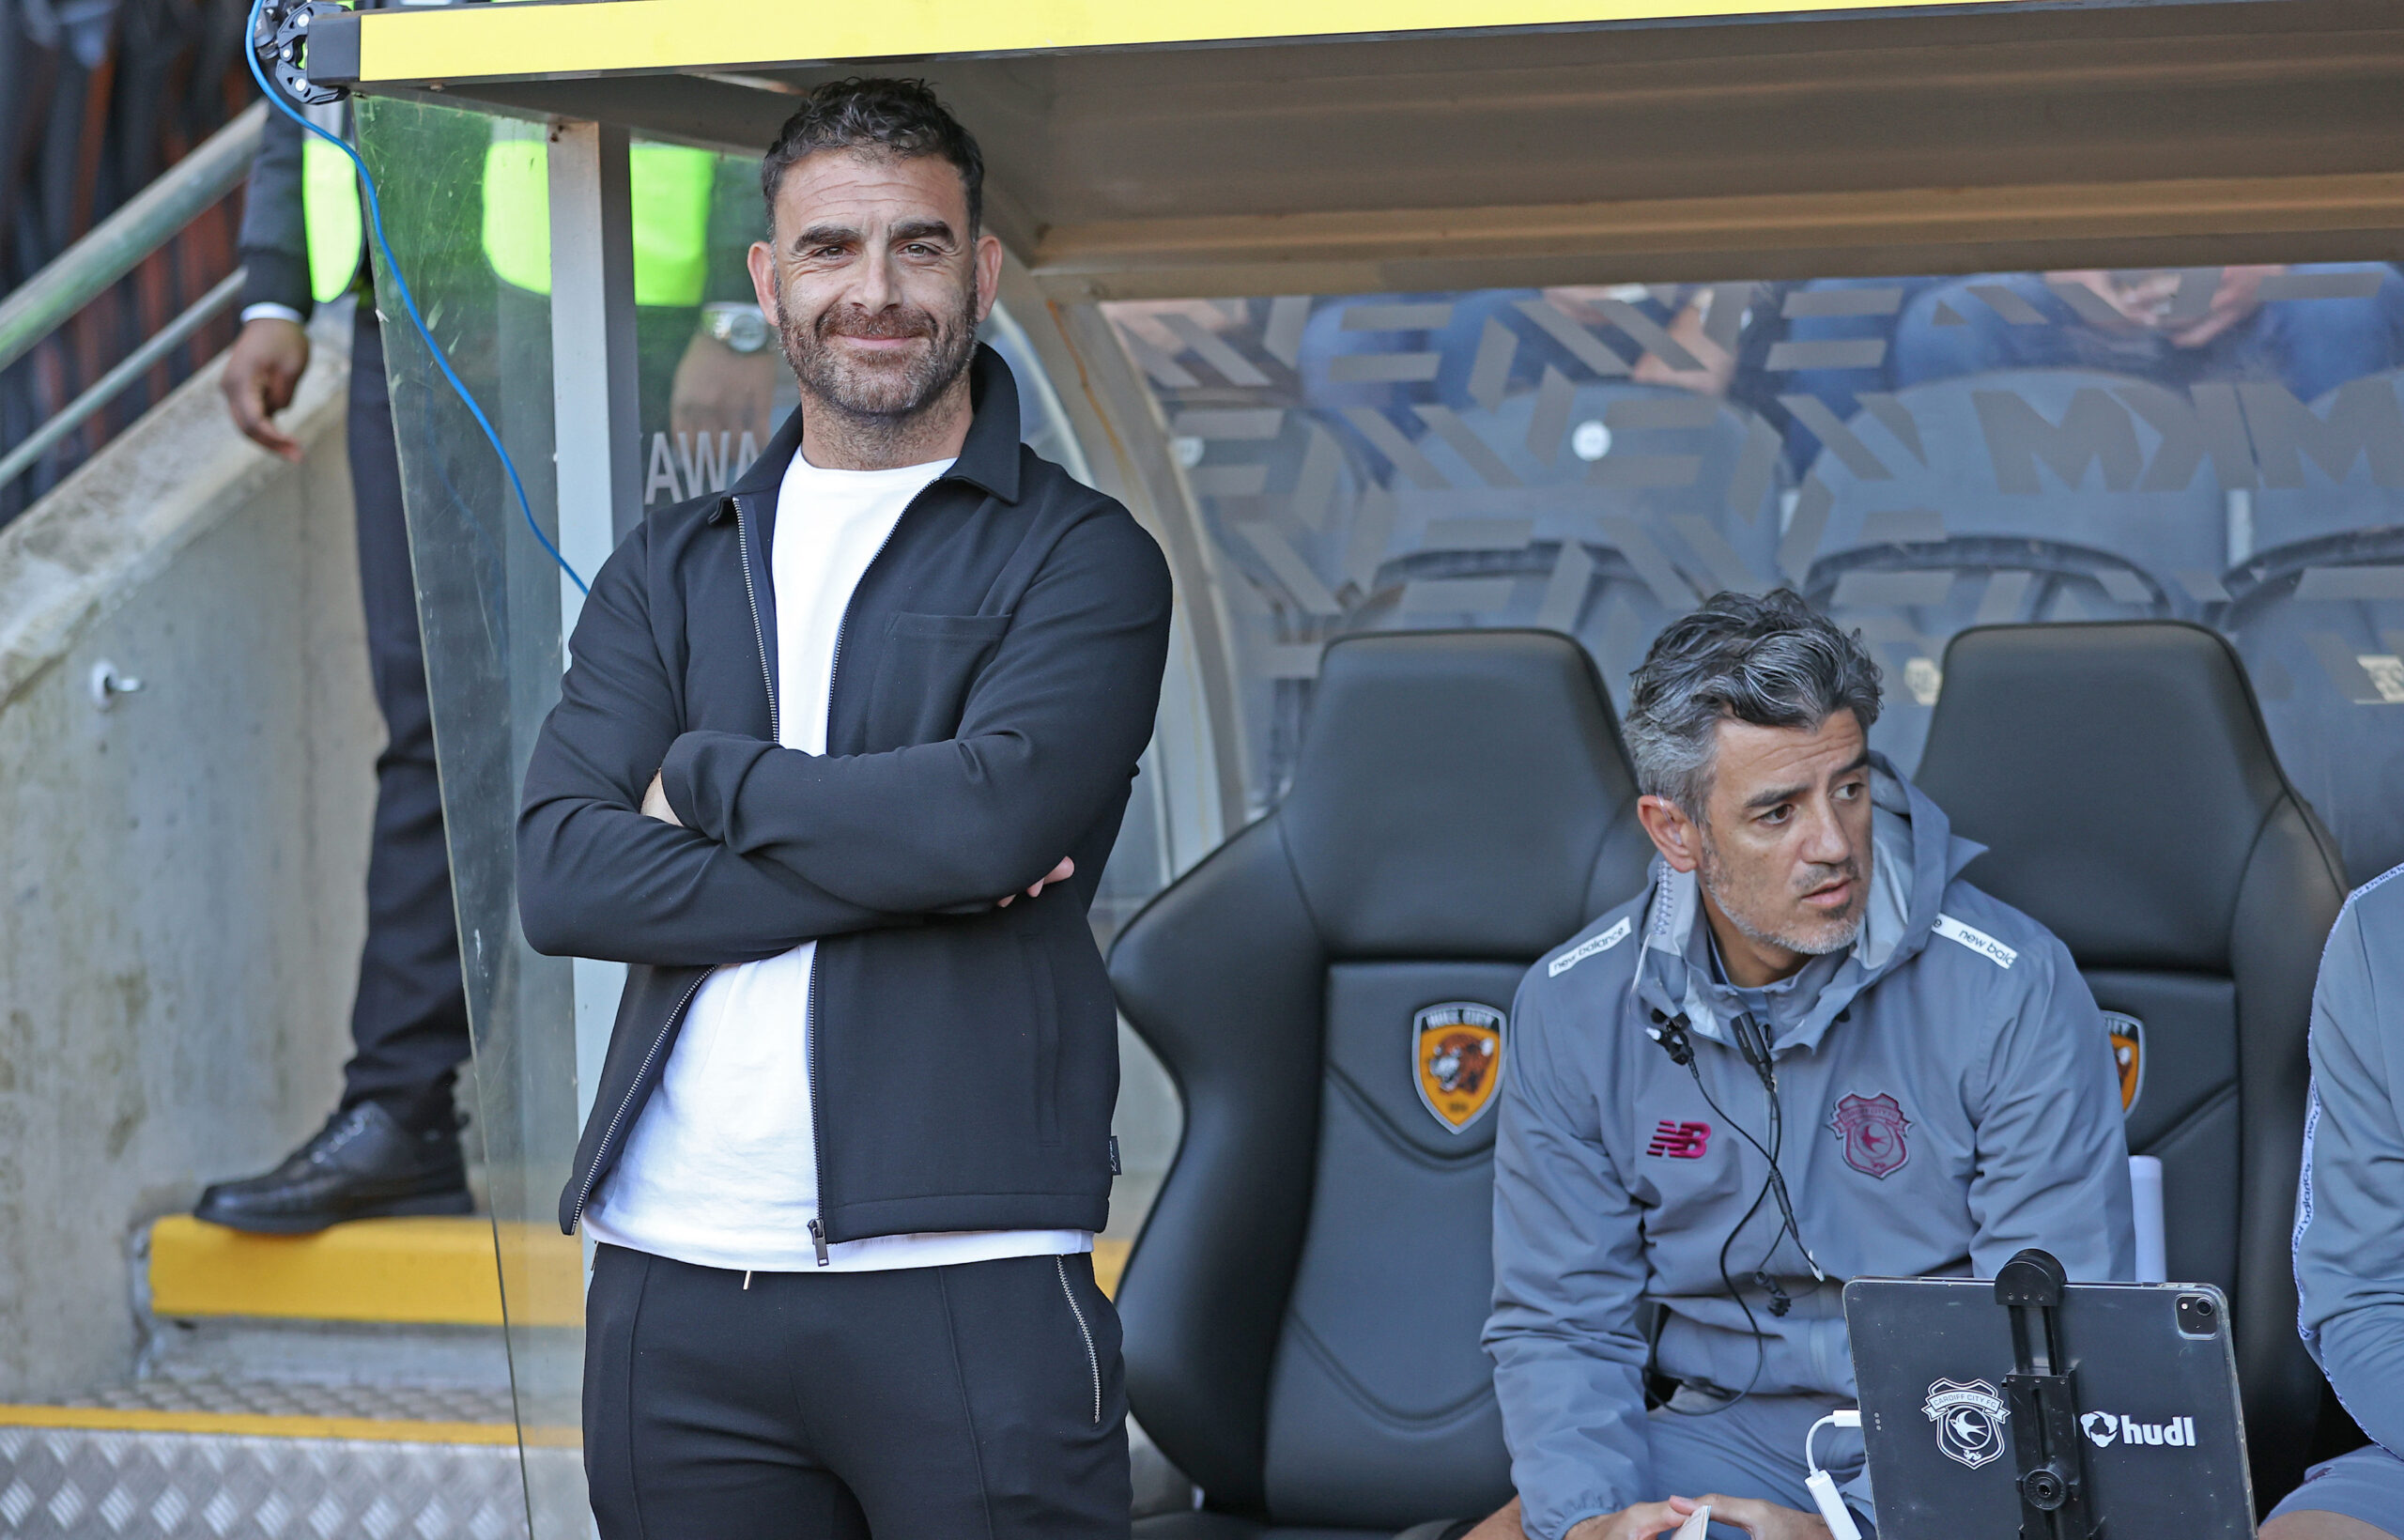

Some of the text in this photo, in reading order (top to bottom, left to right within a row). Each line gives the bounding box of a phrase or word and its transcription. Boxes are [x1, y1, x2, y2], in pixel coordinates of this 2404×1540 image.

[1959, 930, 1986, 947] new
[2302, 1163, 2313, 1224] balance
[1934, 1394, 1996, 1409] CARDIFF CITY FC
[2120, 1414, 2196, 1447] hudl
